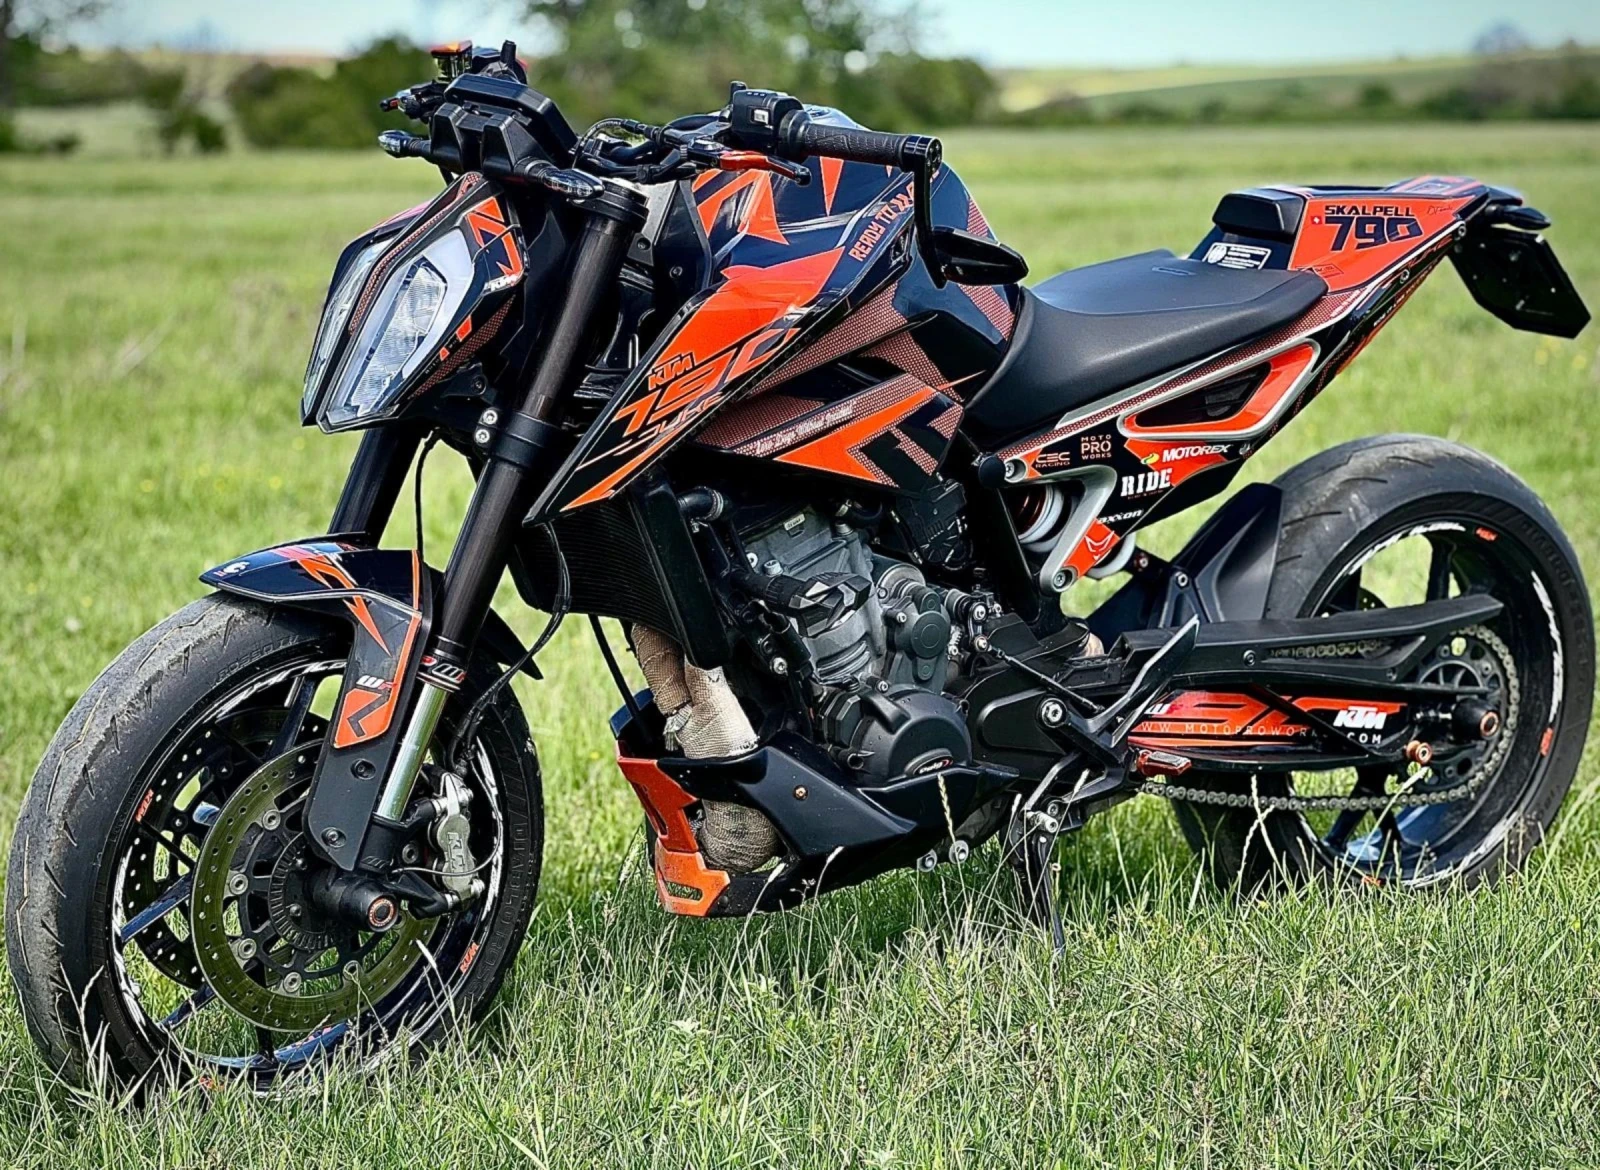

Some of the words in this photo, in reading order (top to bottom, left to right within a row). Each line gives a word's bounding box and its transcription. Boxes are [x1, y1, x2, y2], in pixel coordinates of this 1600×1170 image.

[1324, 205, 1415, 216] SKALPELL
[848, 220, 887, 262] READY
[874, 203, 899, 225] TO
[1324, 215, 1424, 251] 790
[648, 352, 696, 392] KTM
[1080, 440, 1112, 454] PRO
[1081, 434, 1112, 442] MOTO
[1081, 451, 1112, 460] WORKS
[1161, 444, 1232, 463] MOTOREX
[1034, 461, 1071, 469] RACING
[1120, 468, 1173, 497] RIDE
[1332, 706, 1388, 730] KTM
